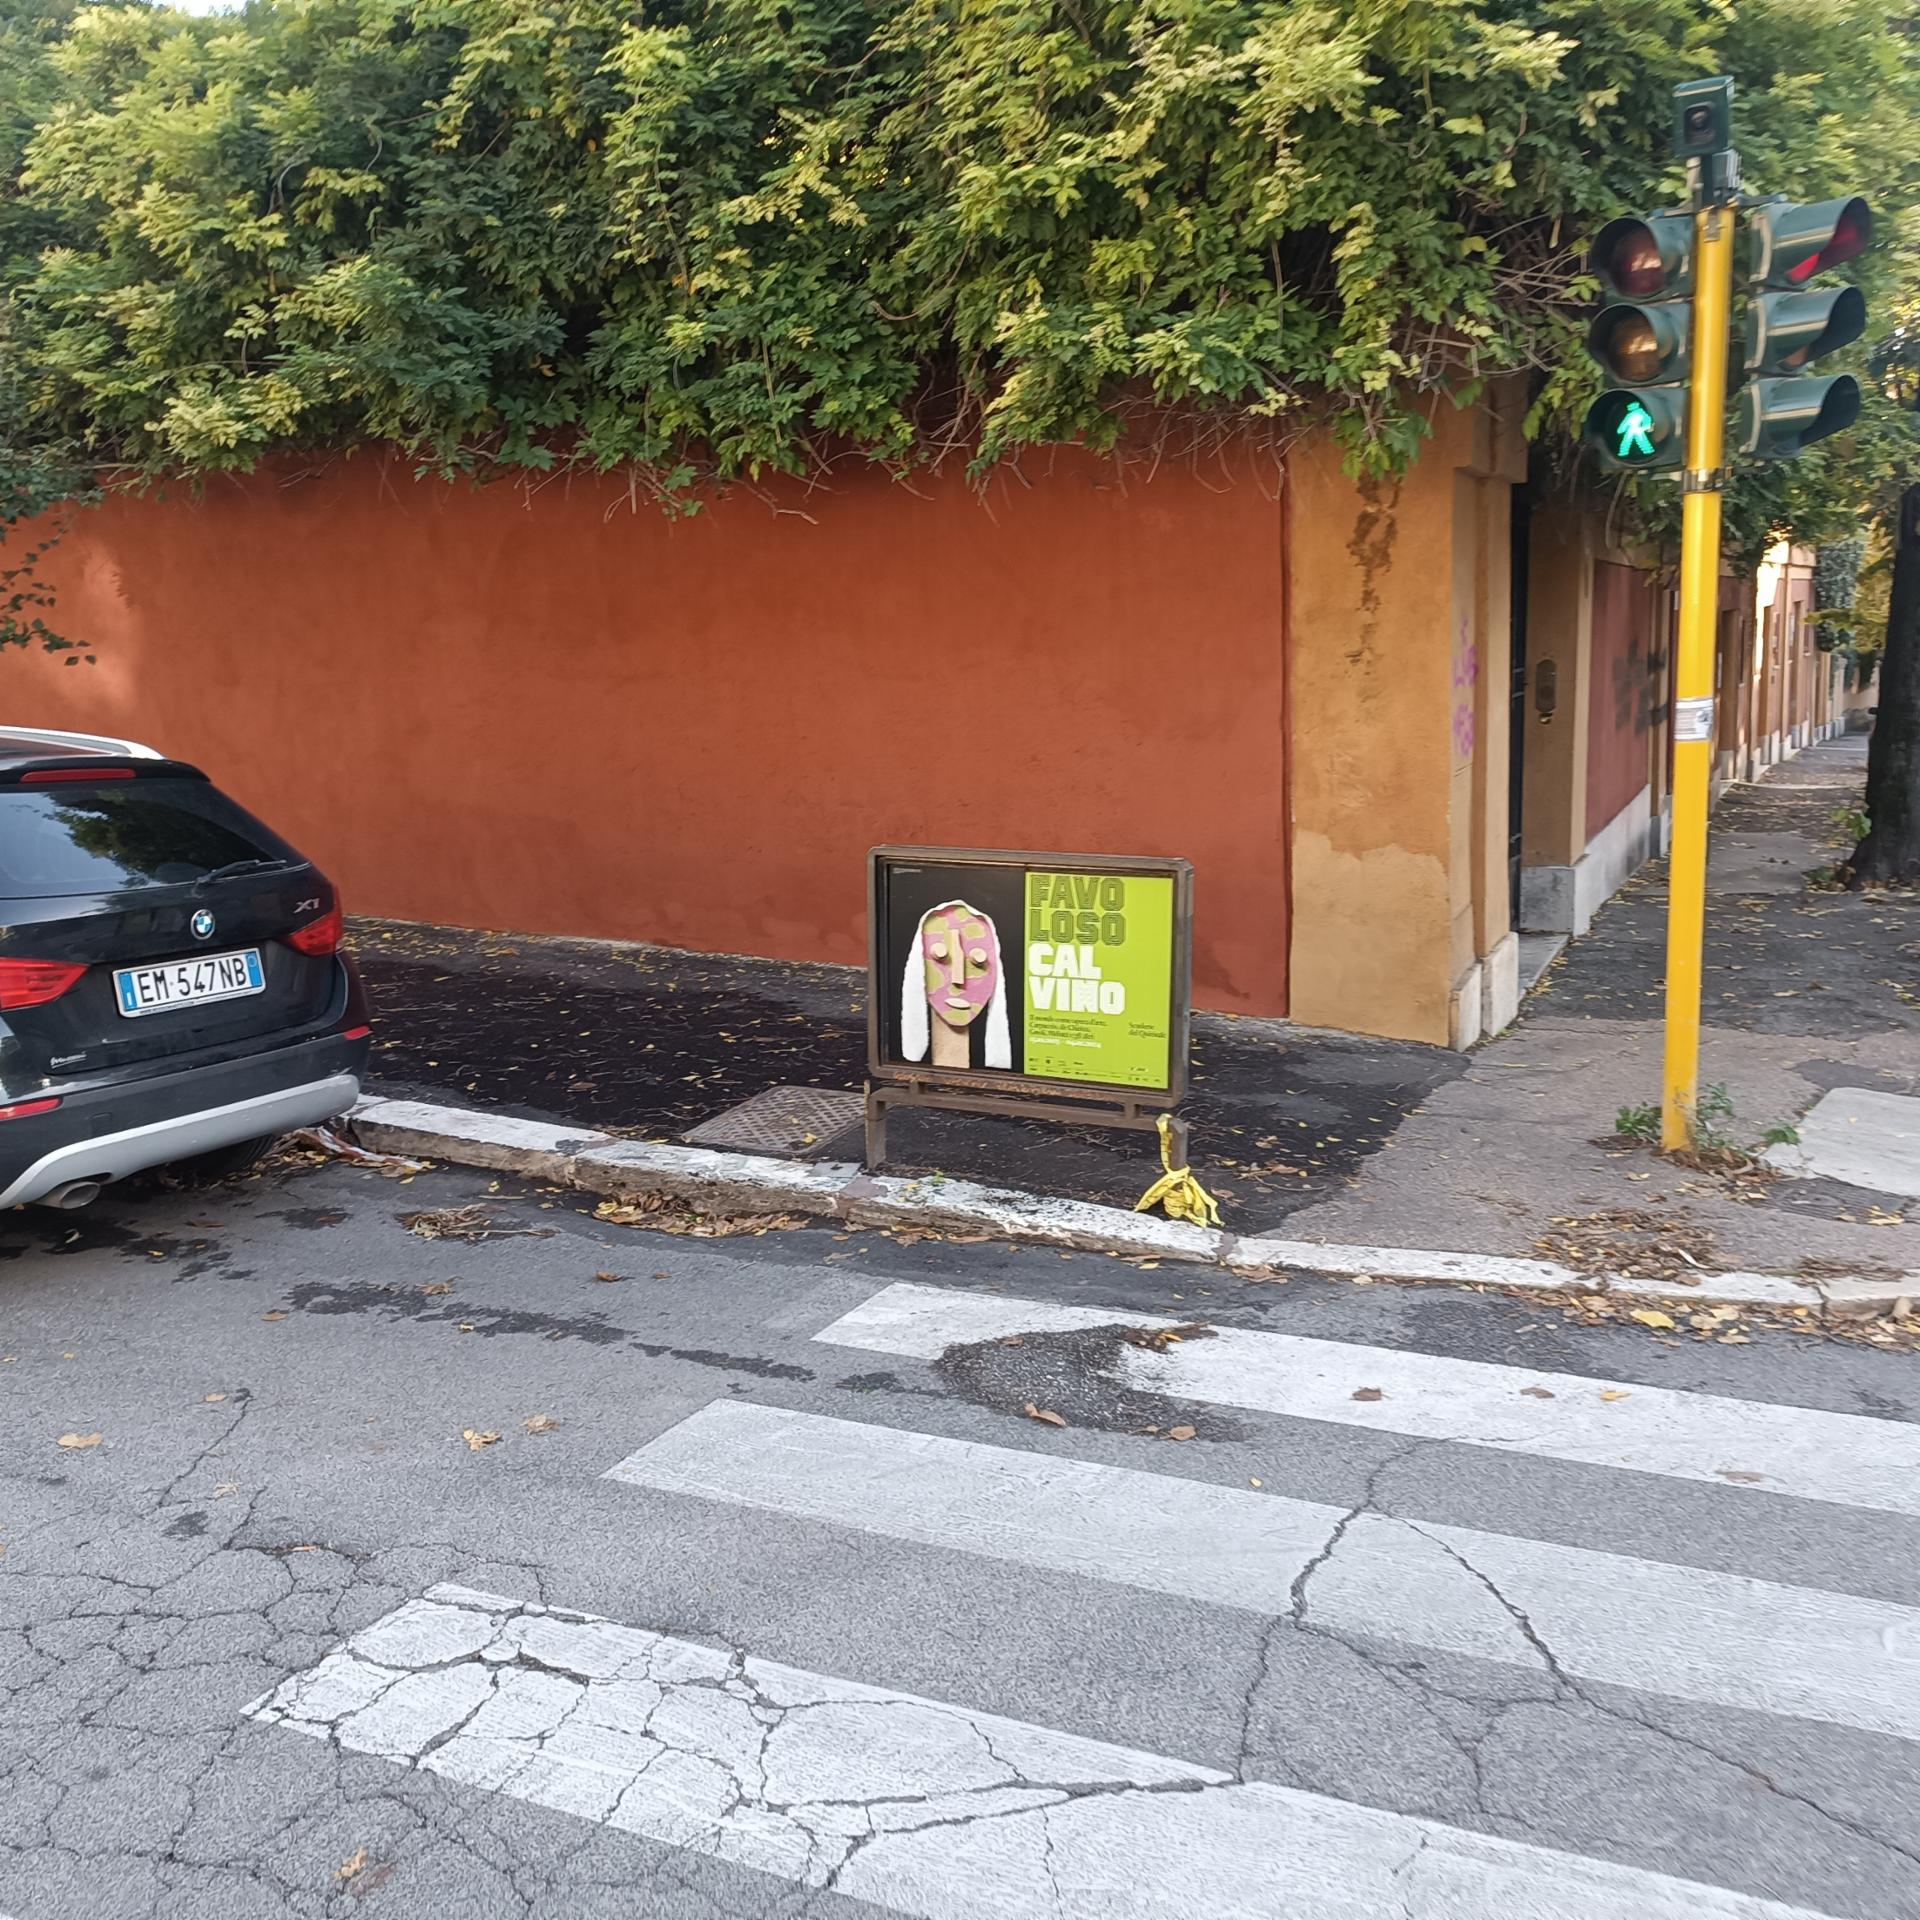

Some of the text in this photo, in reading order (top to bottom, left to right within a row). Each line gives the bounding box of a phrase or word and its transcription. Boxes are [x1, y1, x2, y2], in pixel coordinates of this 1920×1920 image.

[293, 898, 320, 914] X1
[1030, 875, 1124, 911] FAVO
[1030, 909, 1126, 946] LOSO
[1029, 942, 1102, 980] CAL
[1029, 976, 1125, 1015] VINO
